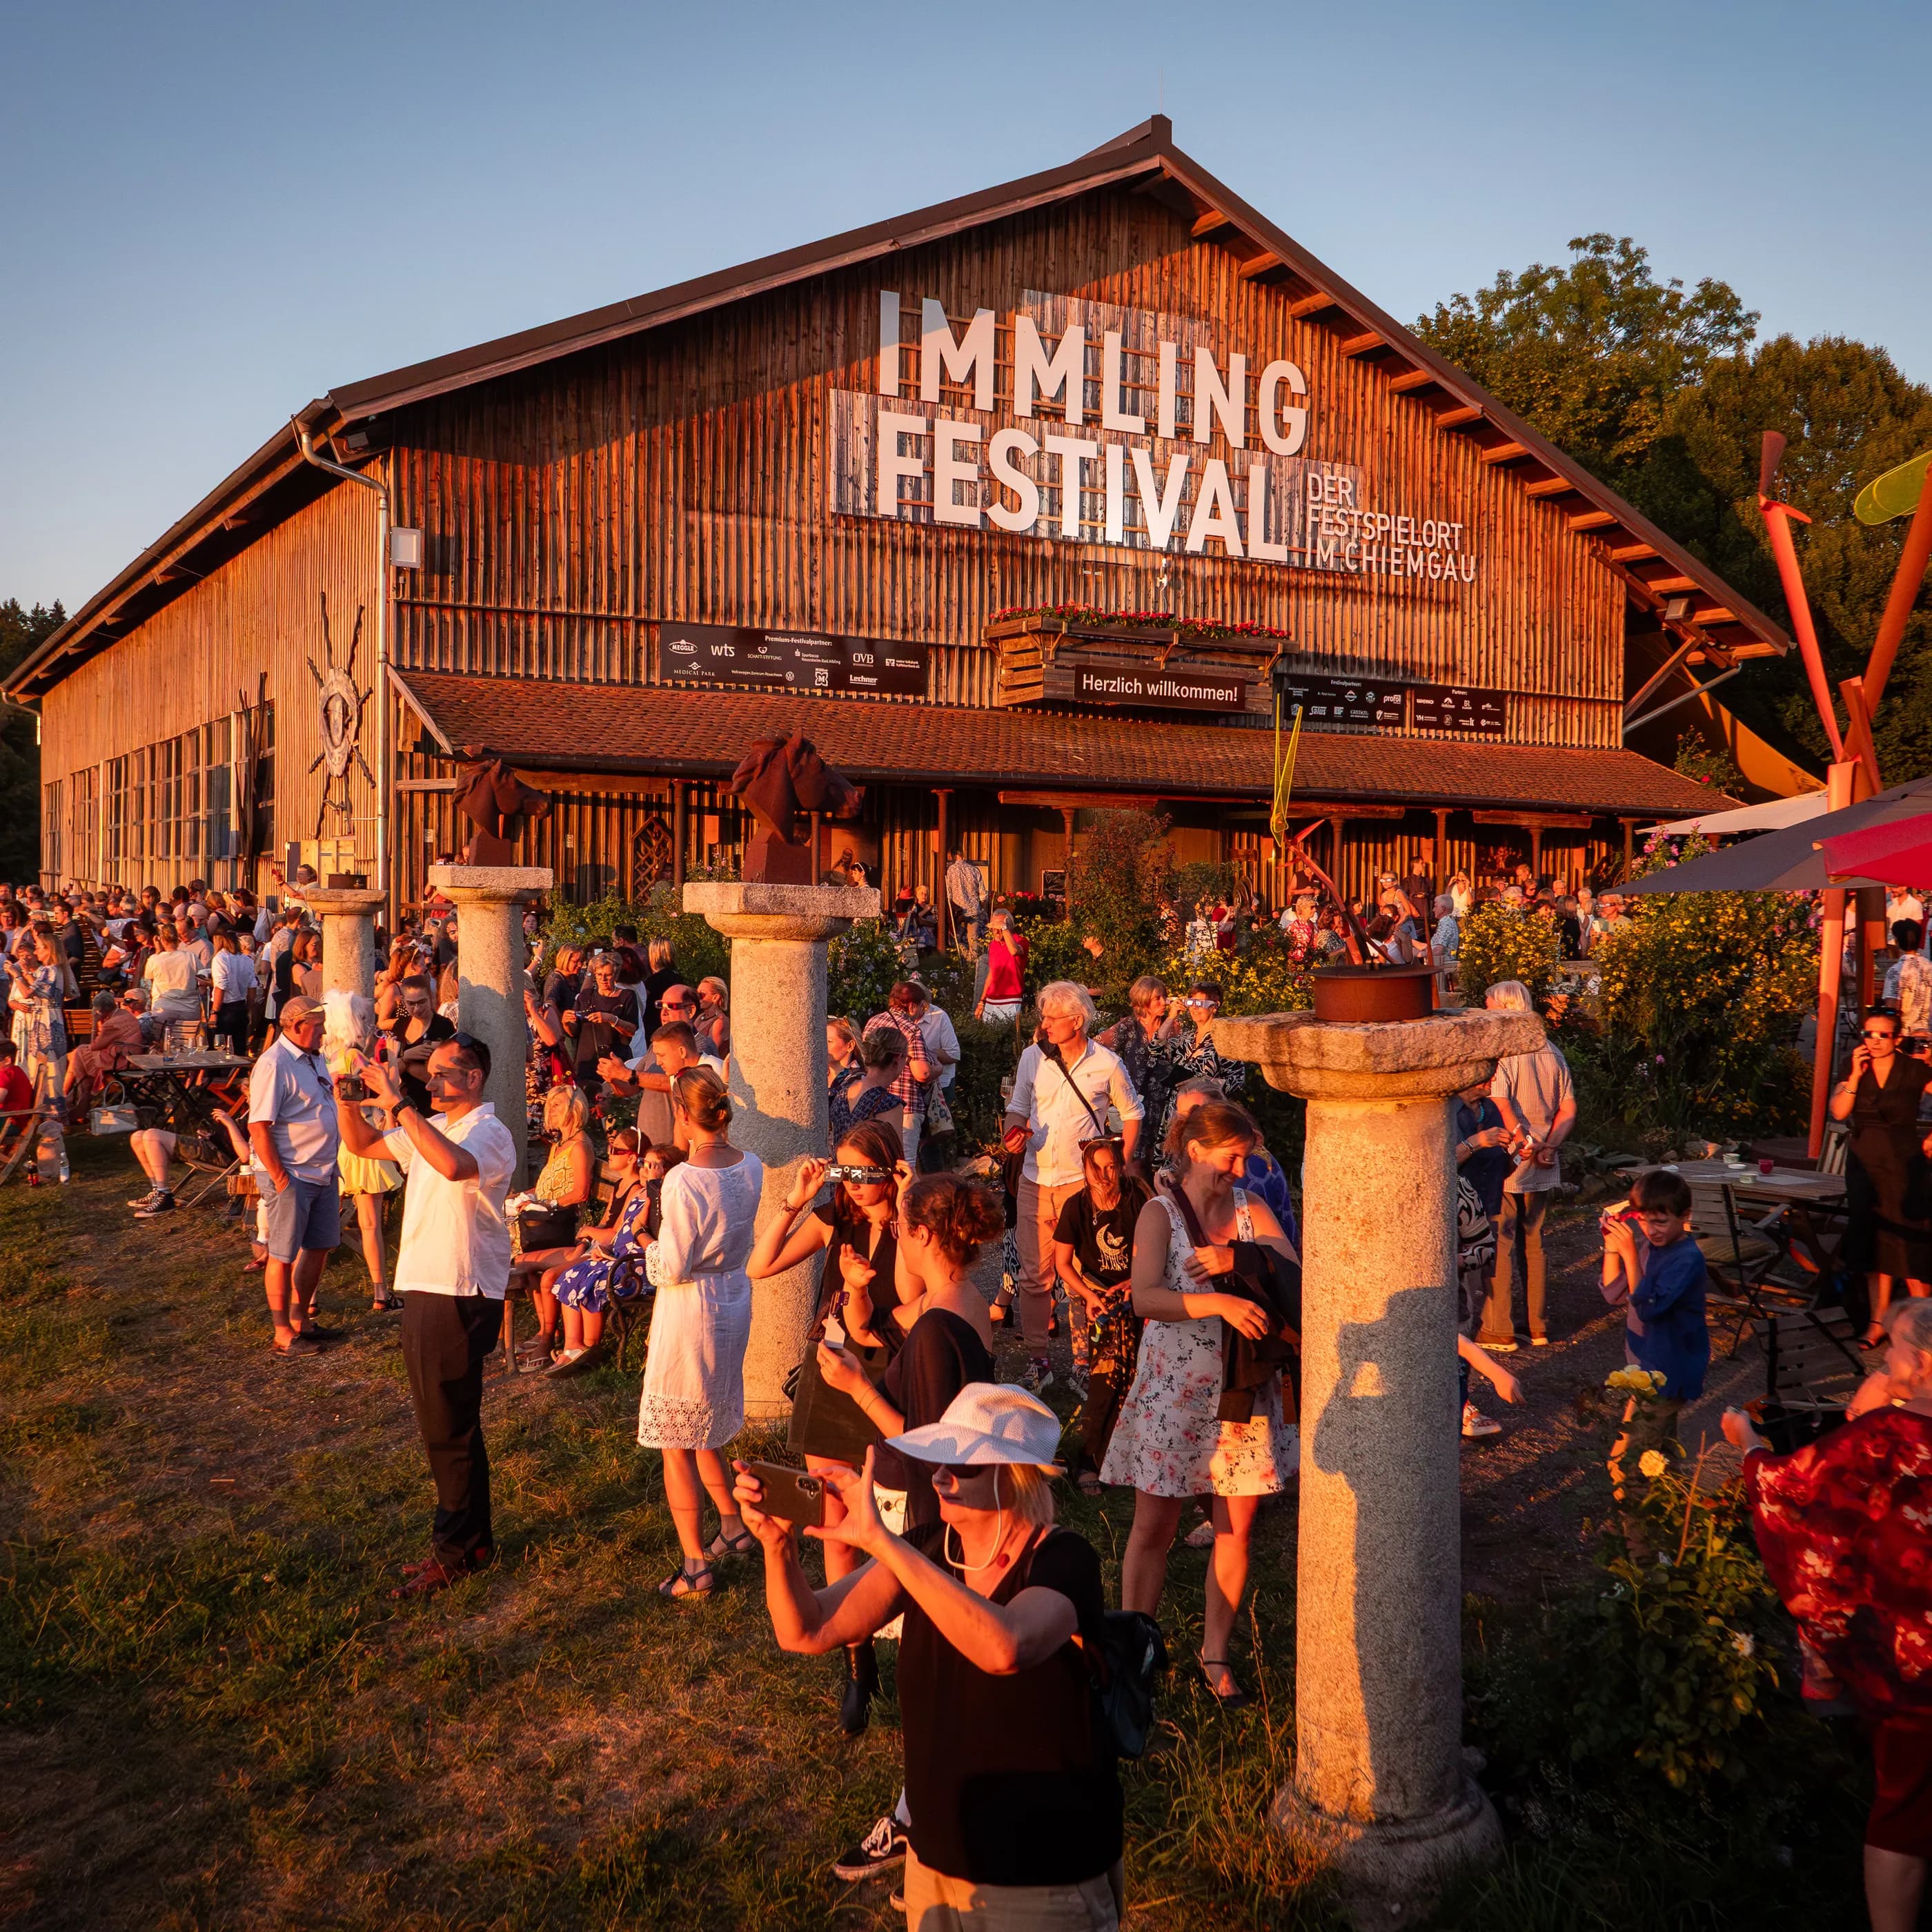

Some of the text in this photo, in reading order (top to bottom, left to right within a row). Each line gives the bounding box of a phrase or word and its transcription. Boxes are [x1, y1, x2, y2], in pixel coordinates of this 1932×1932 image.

[879, 289, 1308, 456] IMMLING
[877, 411, 1288, 562] FESTIVAL
[1308, 473, 1352, 506] DER
[1308, 504, 1463, 551] FESTSPIELORT
[1307, 538, 1474, 582] IM CHIEMGAU
[711, 643, 735, 657] wts
[765, 635, 832, 646] Premium-Festivalpartner:
[853, 653, 874, 664] OVB
[849, 674, 878, 683] Lechner
[1083, 673, 1238, 702] Herzlich willkommen!
[1309, 706, 1327, 716] Salus
